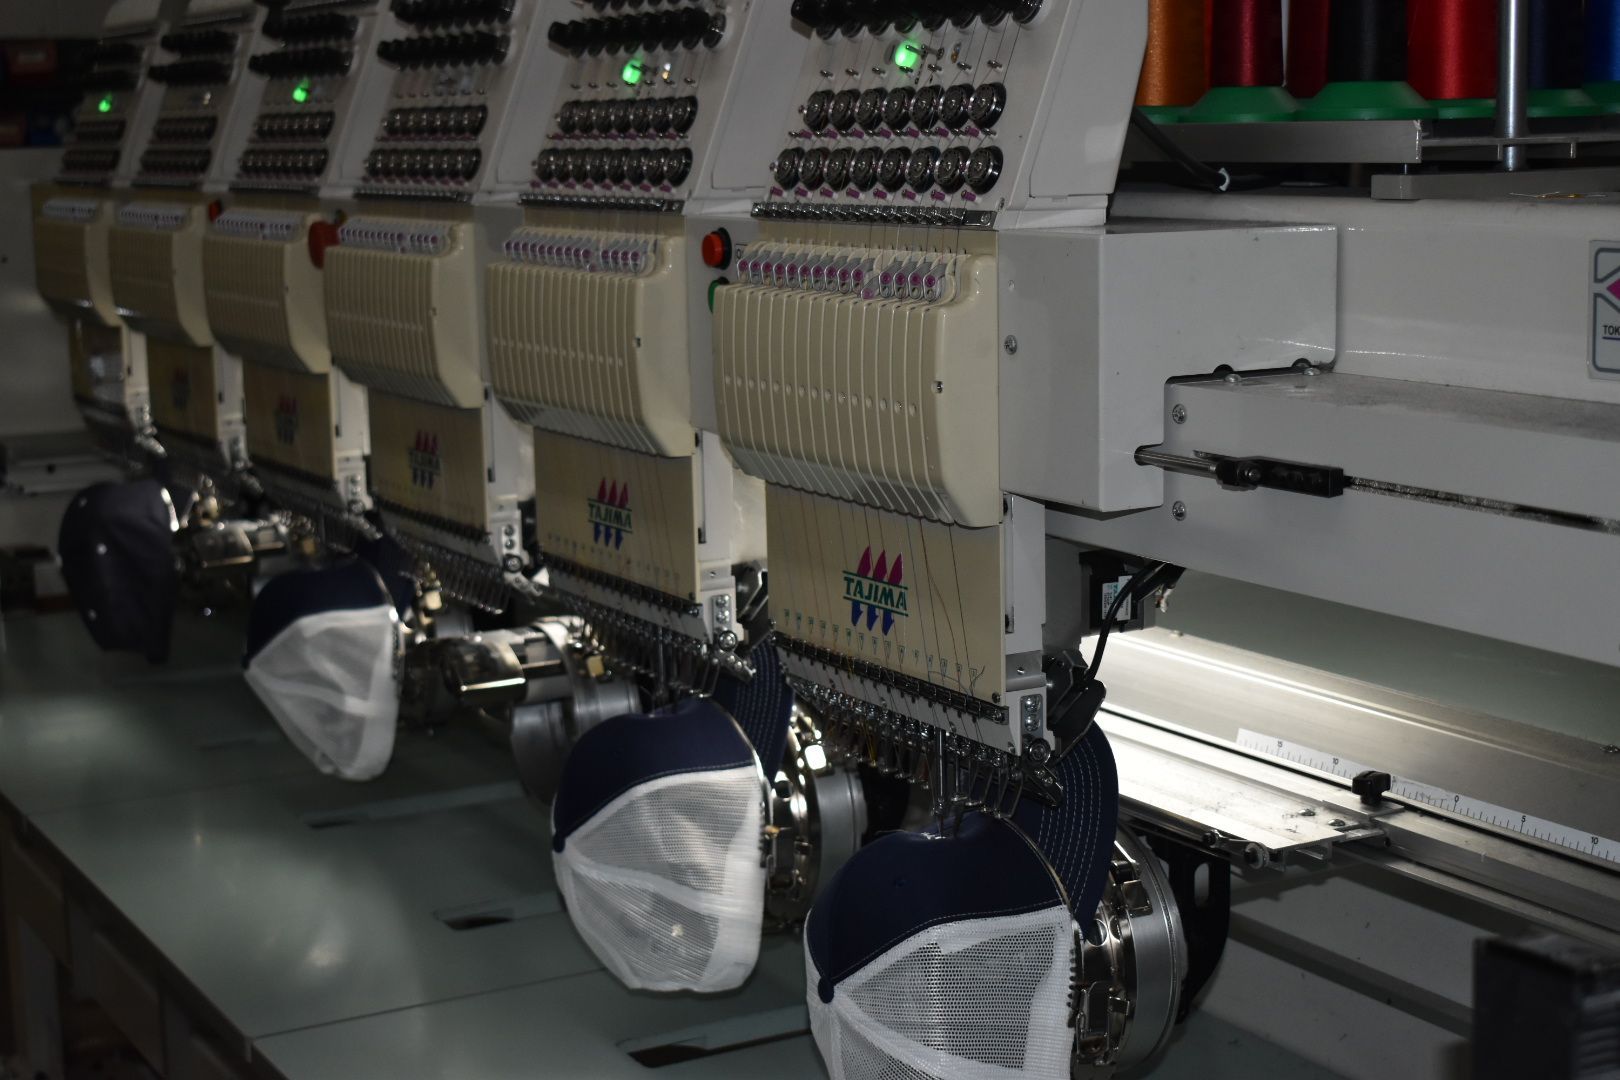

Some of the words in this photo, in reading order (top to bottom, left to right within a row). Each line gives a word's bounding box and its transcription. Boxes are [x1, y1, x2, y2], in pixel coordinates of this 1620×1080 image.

[588, 502, 632, 529] TAJIMA
[843, 576, 907, 611] TAJIMA
[1332, 757, 1339, 765] 10
[1521, 815, 1527, 823] 5
[1591, 836, 1599, 845] 10
